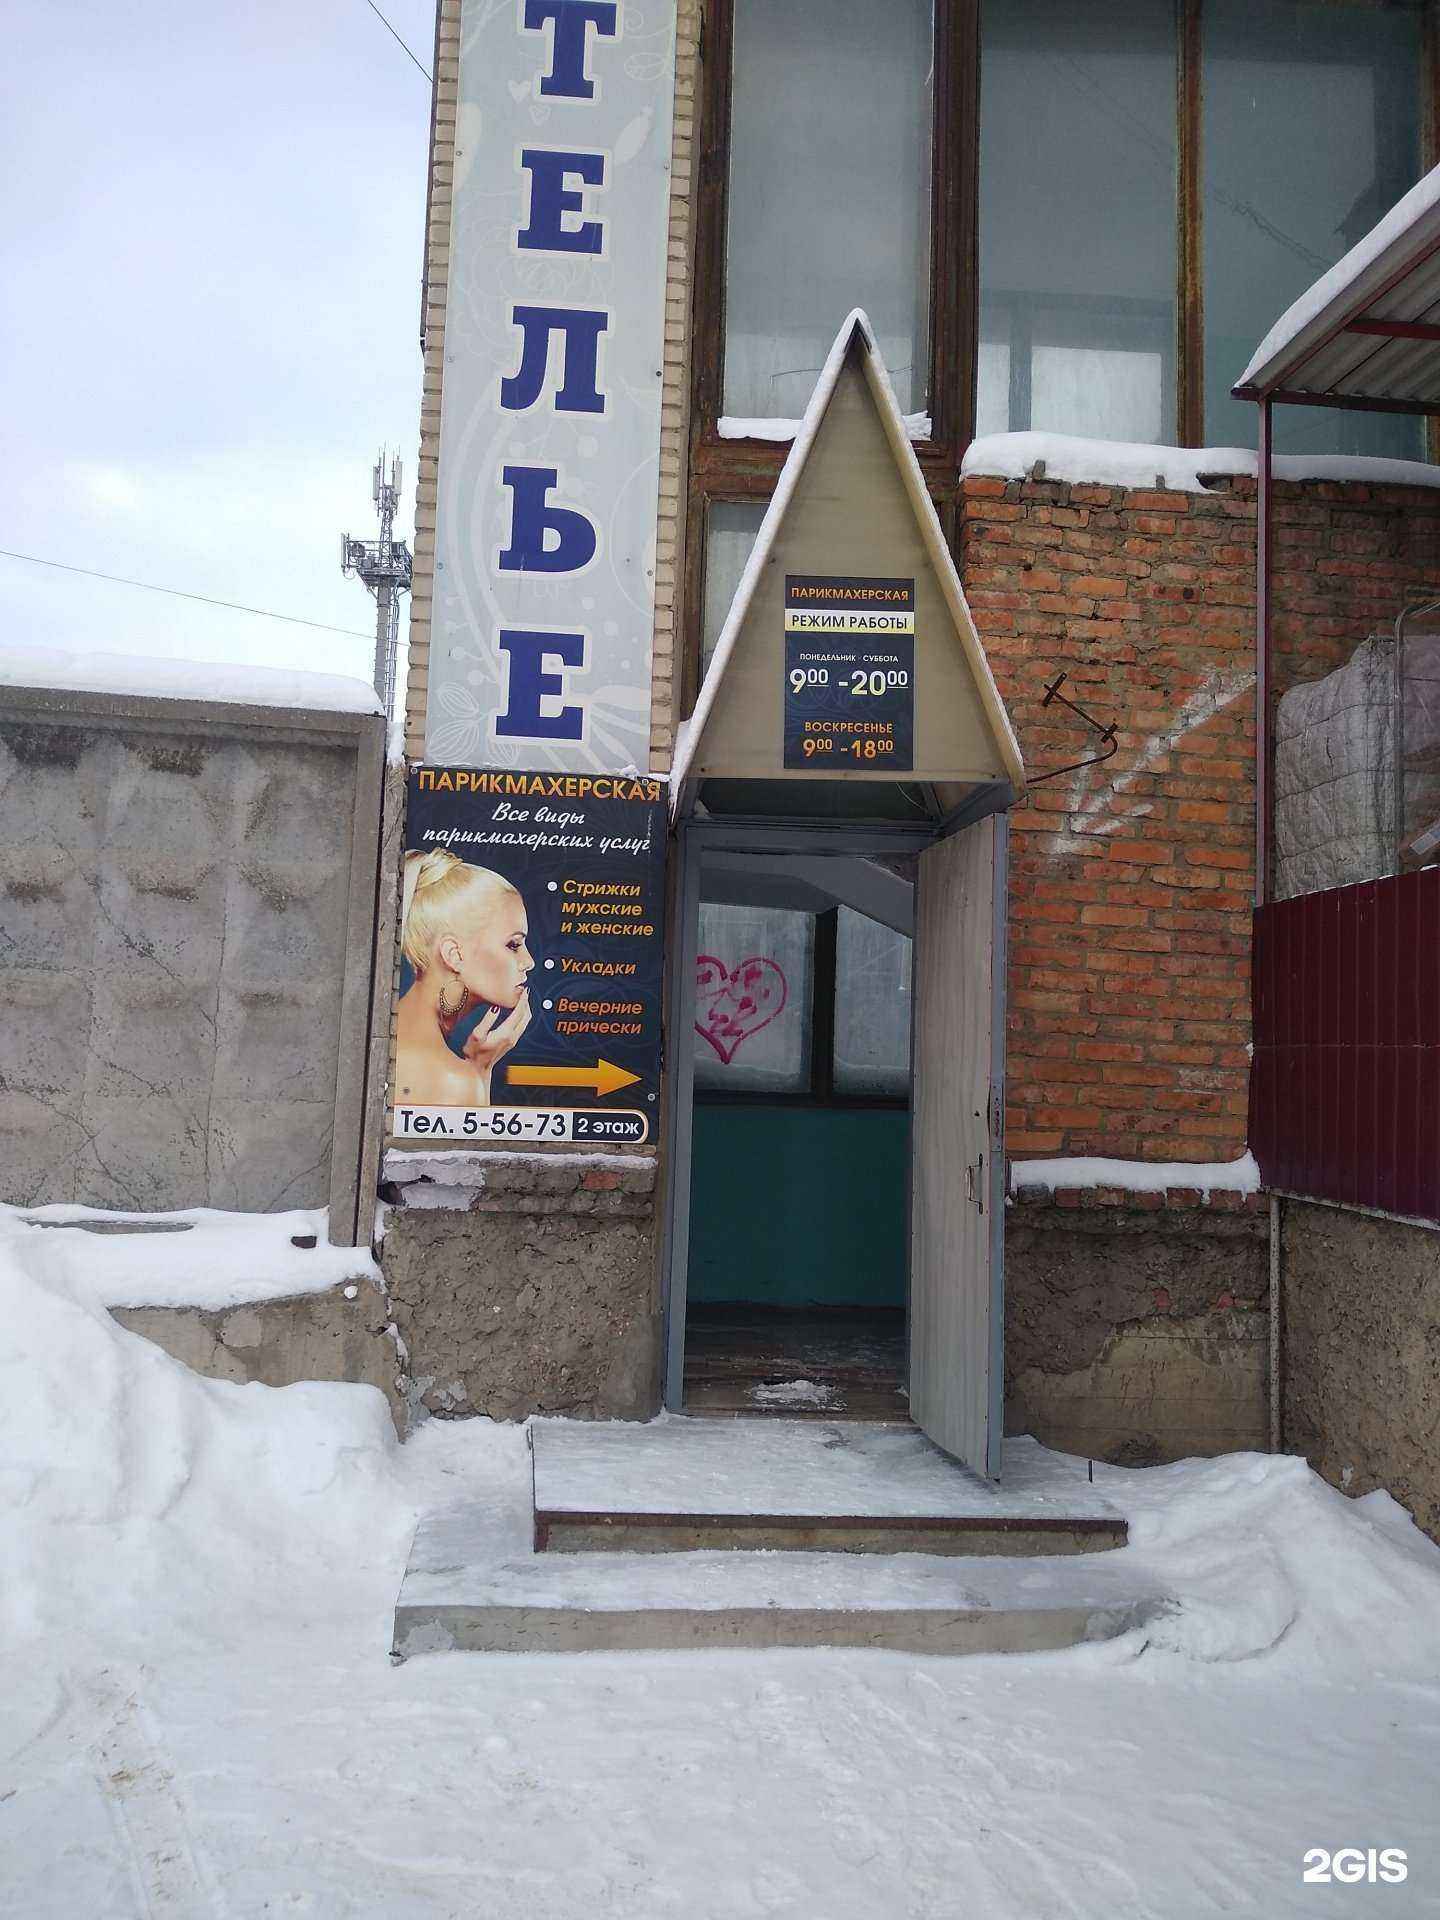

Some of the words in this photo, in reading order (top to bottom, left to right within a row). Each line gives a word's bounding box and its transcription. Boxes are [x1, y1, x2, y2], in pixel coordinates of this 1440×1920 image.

[791, 587, 909, 601] ПАРИКМАХЕРСКАЯ
[792, 615, 845, 628] РЕЖИМ
[849, 617, 907, 629] РАБОТЫ
[800, 653, 856, 662] ПОНЕДЕЛЬНИК
[862, 654, 899, 663] СУББОТА
[804, 722, 893, 734] ВОСКРЕСЕНЬЕ
[418, 770, 661, 801] ПАРИКМАХЕРСКАЯ
[491, 801, 529, 822] Все
[534, 806, 585, 829] виды
[422, 827, 594, 851] парикмахерских
[599, 837, 650, 856] услуг
[562, 880, 641, 897] Стрижки
[561, 902, 643, 916] мужские
[560, 922, 572, 934] и
[576, 923, 655, 936] женские
[561, 959, 637, 975] Укладки
[556, 999, 643, 1015] Вечерние
[556, 1020, 642, 1035] прически
[401, 1110, 454, 1134] Тел.
[462, 1112, 567, 1137] 5-56-73
[577, 1118, 588, 1133] 2
[592, 1120, 639, 1135] этаж
